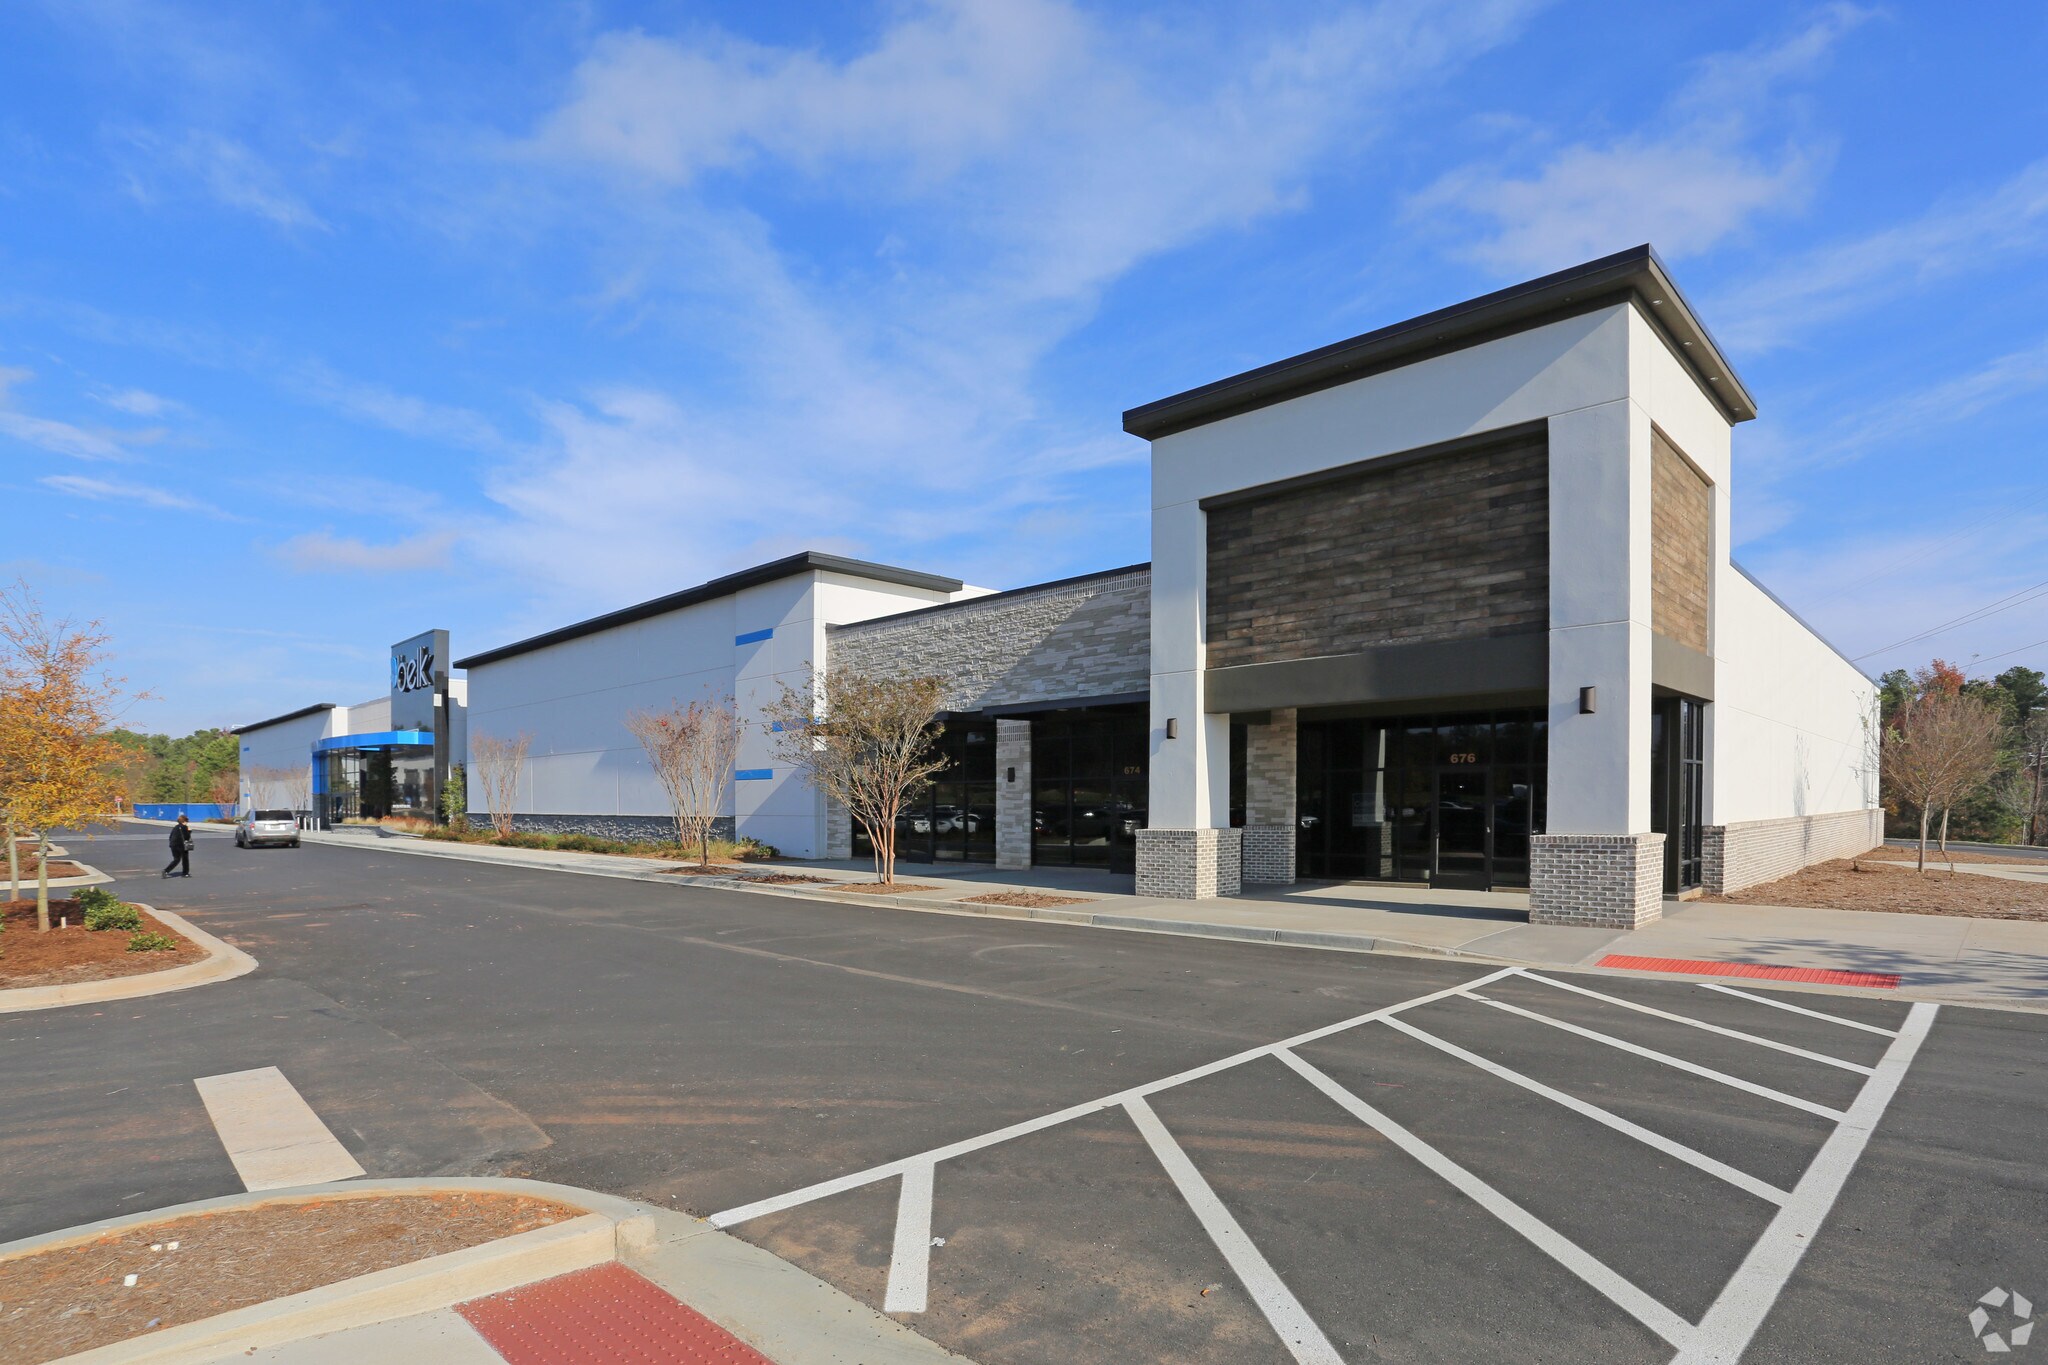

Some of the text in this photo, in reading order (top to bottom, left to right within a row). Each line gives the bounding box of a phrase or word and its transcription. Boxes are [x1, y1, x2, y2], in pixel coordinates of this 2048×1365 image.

[397, 646, 434, 693] belk
[1450, 753, 1476, 764] 676
[1123, 766, 1141, 775] 674
